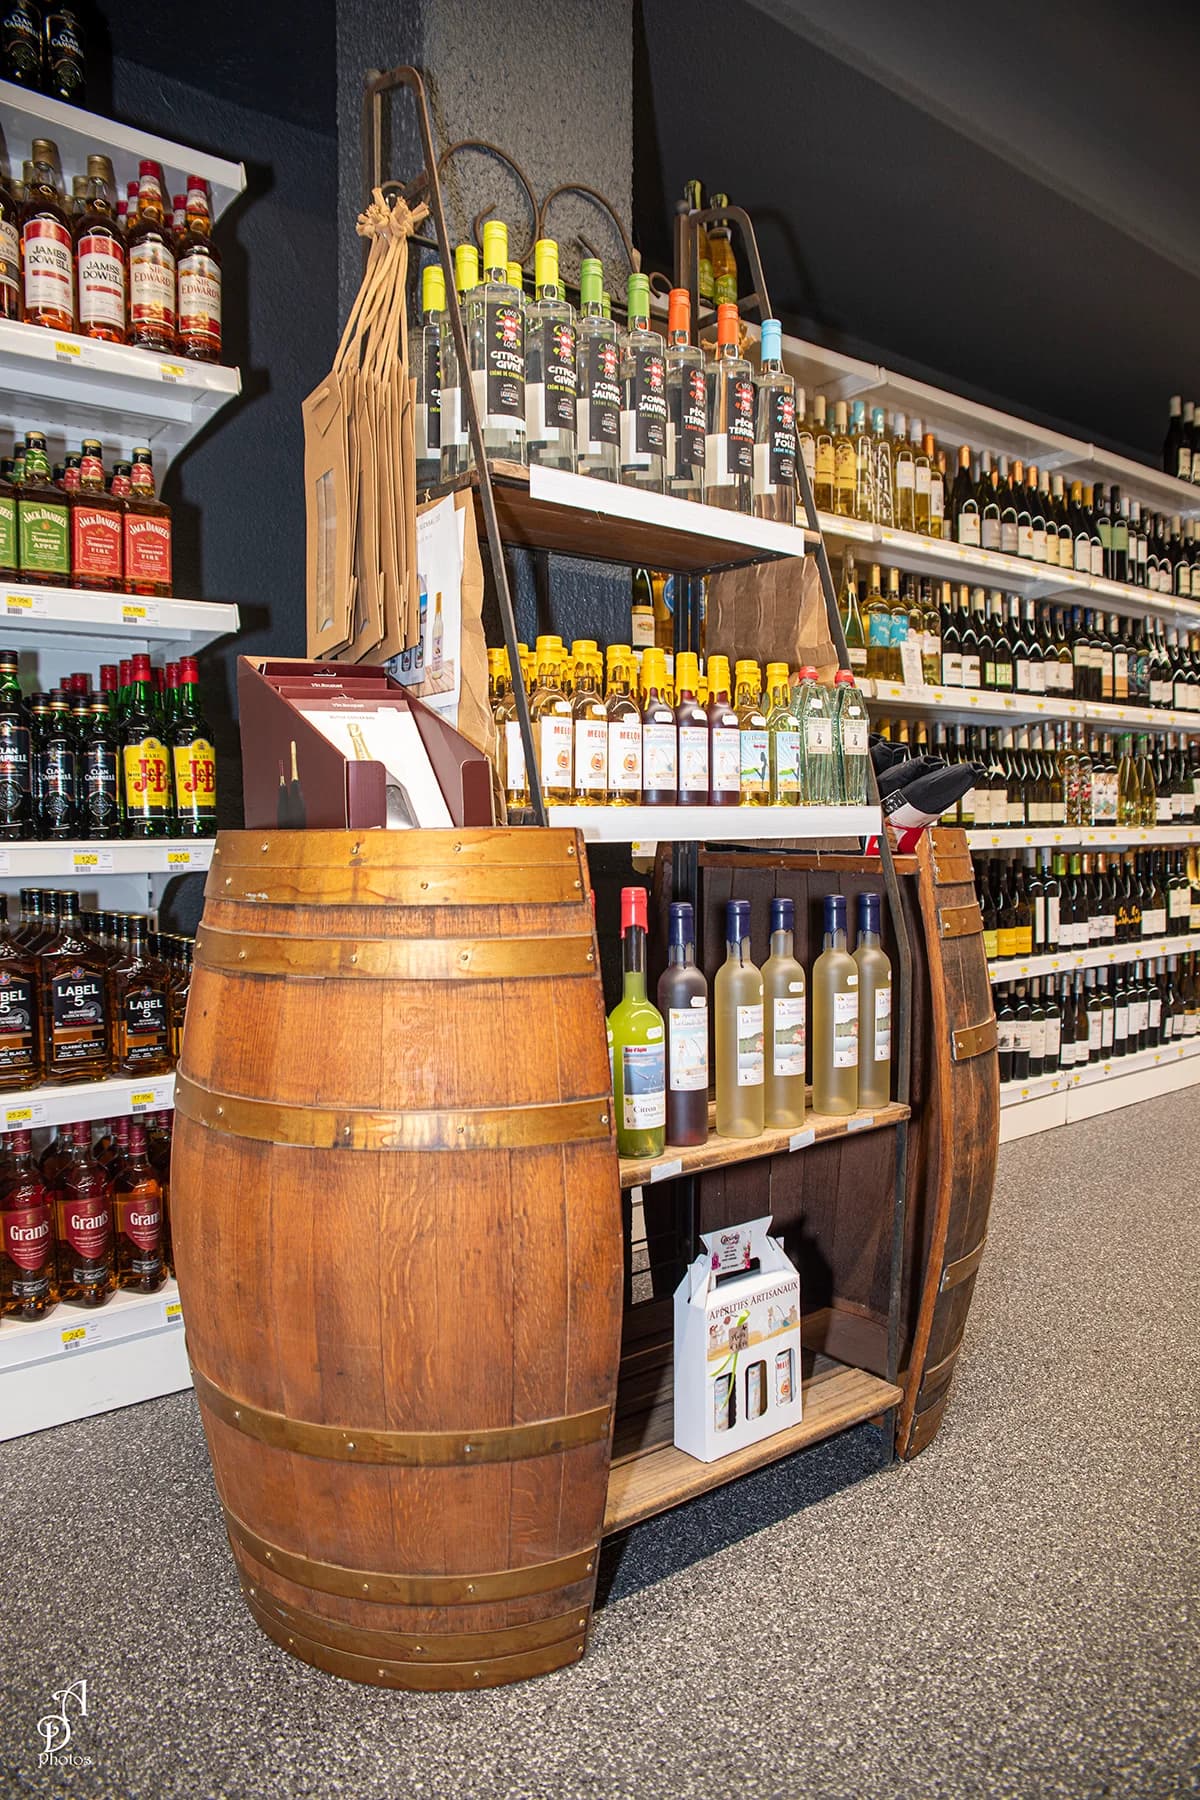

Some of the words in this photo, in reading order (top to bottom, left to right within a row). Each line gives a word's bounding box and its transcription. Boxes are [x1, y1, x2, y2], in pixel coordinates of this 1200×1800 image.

[32, 245, 67, 262] JAMES
[86, 260, 119, 275] JAMES
[90, 768, 109, 776] CLAN
[133, 759, 168, 793] J&B
[184, 760, 216, 793] J&B
[57, 984, 99, 997] LABEL
[74, 995, 84, 1006] 5
[129, 999, 163, 1010] LABEL
[143, 1009, 151, 1018] 5
[749, 1279, 798, 1305] ARTISANAUX
